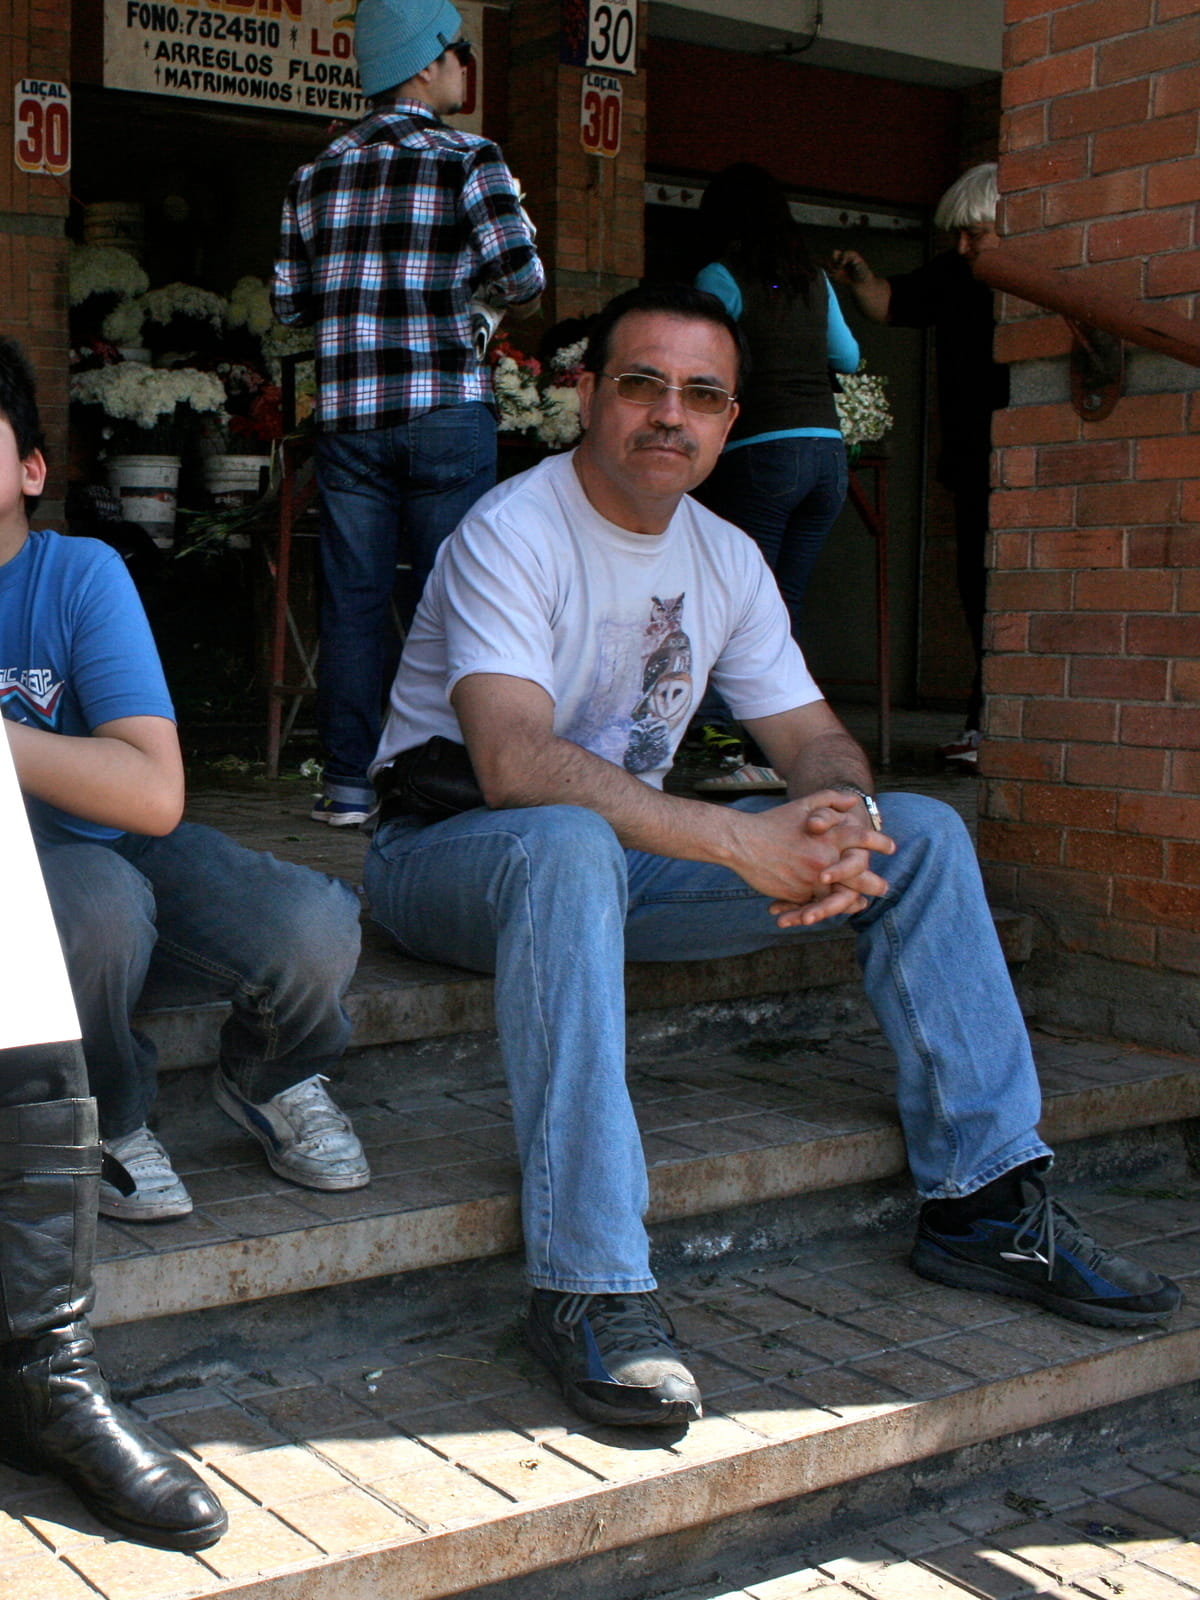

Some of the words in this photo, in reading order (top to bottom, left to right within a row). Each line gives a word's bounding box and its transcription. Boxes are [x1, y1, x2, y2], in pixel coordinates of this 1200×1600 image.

[311, 27, 356, 59] LO
[591, 5, 633, 64] 30
[154, 40, 273, 77] ARREGLOS
[288, 59, 363, 89] FLORAL
[586, 73, 620, 92] LOCAL
[21, 80, 67, 98] LOCAL
[164, 66, 293, 103] MATRIMONIOS
[305, 85, 371, 112] EVENT
[18, 99, 69, 167] 30
[583, 91, 619, 150] 30
